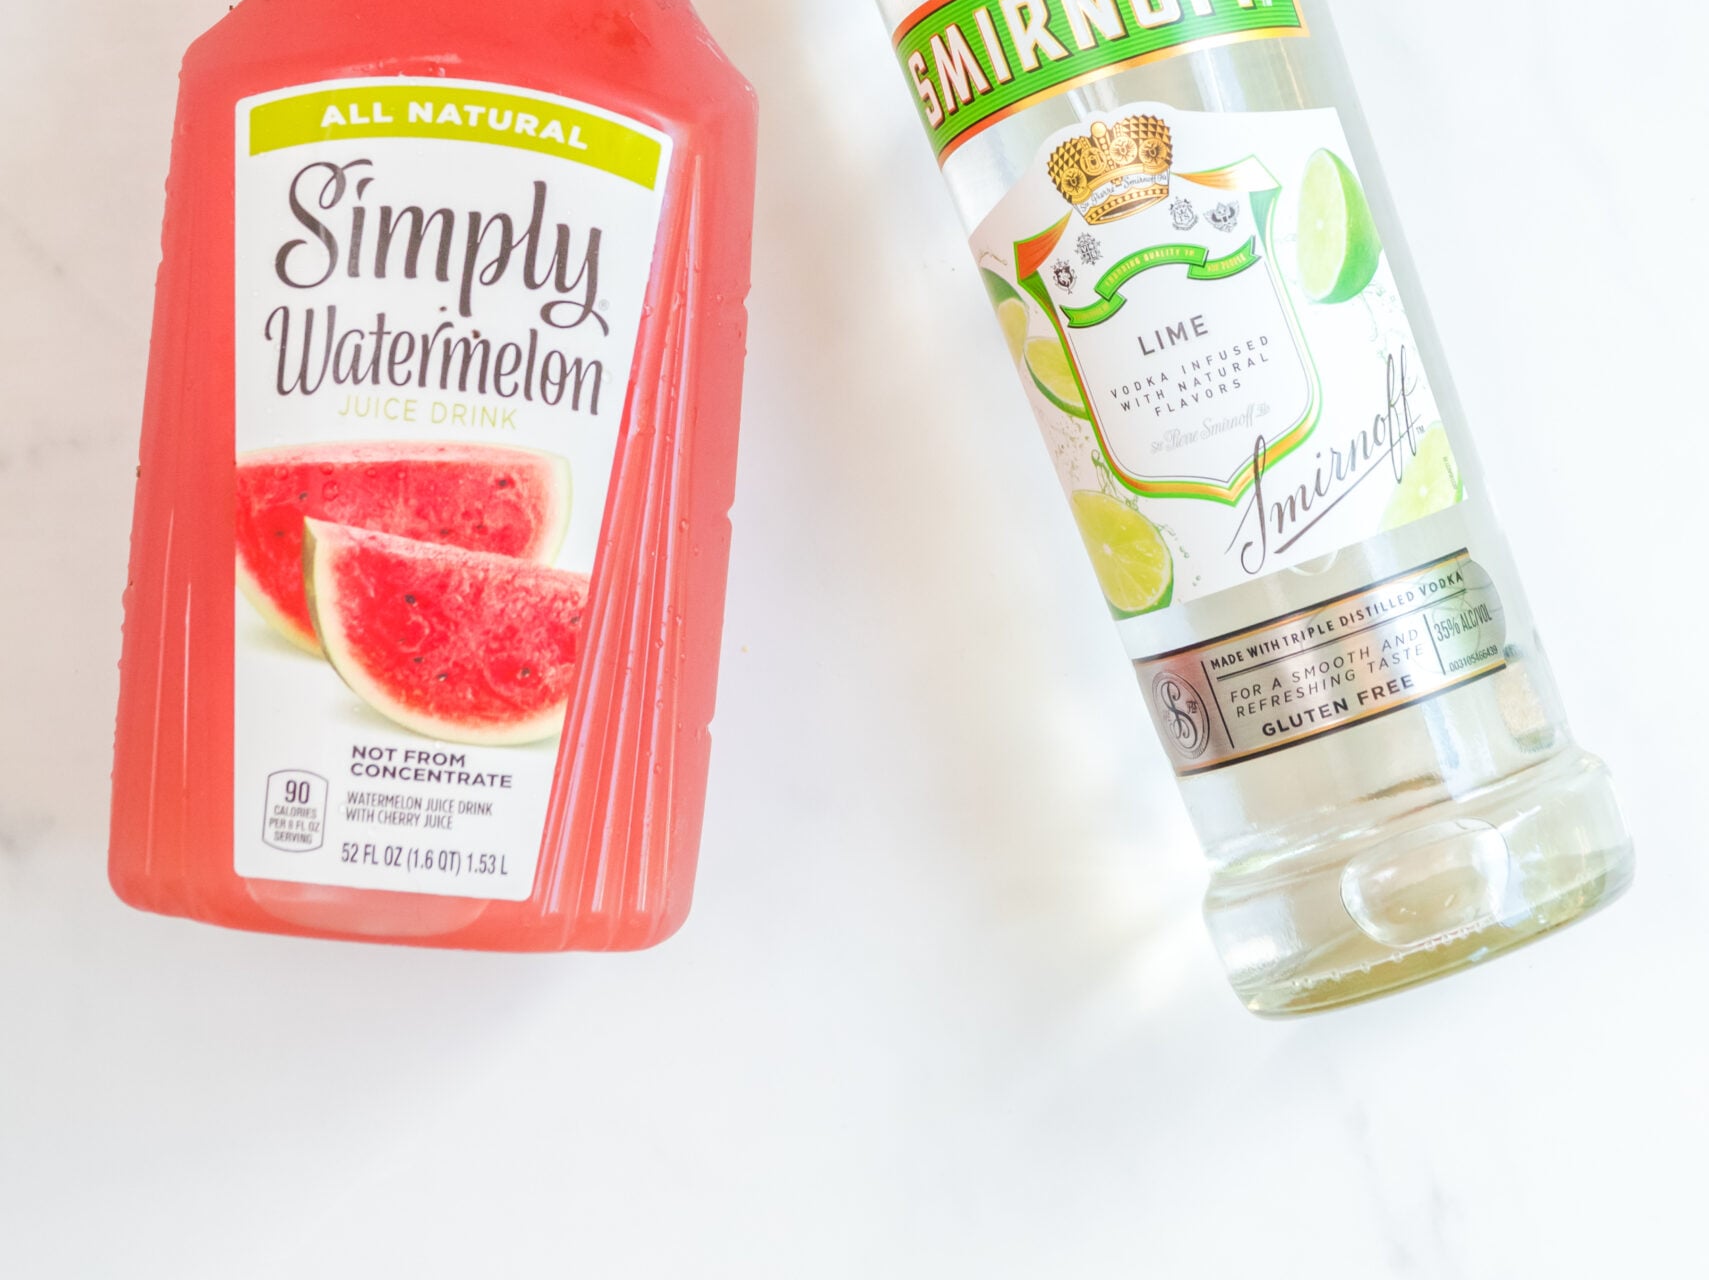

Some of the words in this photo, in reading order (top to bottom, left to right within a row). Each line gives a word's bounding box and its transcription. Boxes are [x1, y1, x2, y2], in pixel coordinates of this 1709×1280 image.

[320, 101, 393, 129] ALL
[408, 101, 589, 151] NATURAL
[275, 158, 610, 337] Simply
[1137, 314, 1209, 356] LIME
[264, 305, 604, 416] Watermelon
[1110, 372, 1169, 399] VODKA
[1181, 335, 1269, 375] INFUSED
[1120, 389, 1165, 413] WITH
[1177, 352, 1270, 393] NATURAL
[1154, 378, 1242, 417] FLAVORS
[338, 394, 417, 422] JUICE
[431, 401, 518, 431] DRINK
[1224, 344, 1421, 575] Smirnoff
[1210, 651, 1244, 670] MADE
[1247, 639, 1280, 659] WITH
[1282, 620, 1334, 646] TRIPLE
[1339, 591, 1415, 627] DISTILLED
[1418, 571, 1463, 596] VODKA
[1434, 616, 1461, 642] 35%
[1230, 684, 1262, 703] FOR
[1272, 677, 1282, 690] A
[1292, 646, 1370, 683] SMOOTH
[1382, 629, 1418, 652] AND
[1236, 669, 1356, 718] REFRESHING
[1367, 644, 1424, 674] TASTE
[1262, 697, 1349, 737] GLUTEN
[1357, 674, 1415, 705] FREE
[350, 762, 513, 789] CONCENTRATE
[351, 745, 398, 763] NOT
[403, 750, 466, 768] FROM
[274, 804, 317, 819] CALORIES
[285, 780, 310, 804] 90
[347, 791, 422, 811] WATERMELON
[425, 798, 455, 813] JUICE
[458, 800, 493, 816] DRINK
[274, 831, 312, 844] SERVING
[346, 806, 374, 823] WITH
[377, 809, 421, 827] CHERRY
[424, 814, 453, 830] JUICE
[341, 842, 359, 863] 52
[363, 843, 379, 865] FL
[384, 845, 404, 867] OZ
[406, 847, 433, 871] (1.6
[438, 850, 461, 876] QT)
[467, 852, 496, 875] 1.53
[500, 854, 508, 875] L
